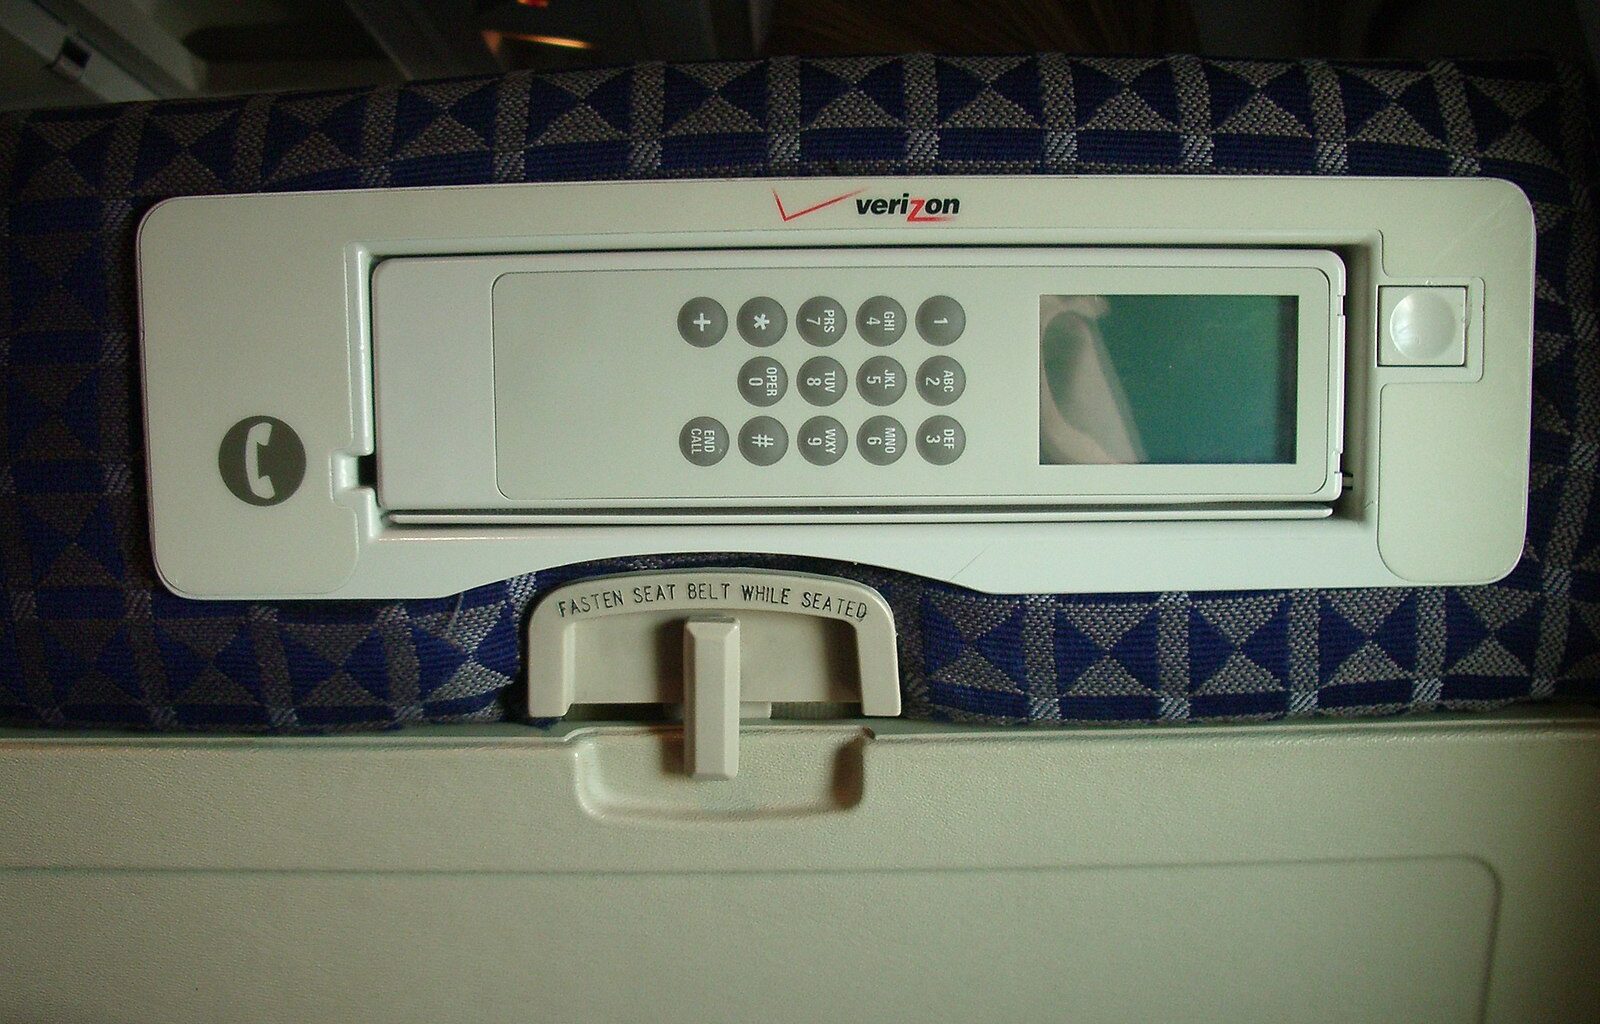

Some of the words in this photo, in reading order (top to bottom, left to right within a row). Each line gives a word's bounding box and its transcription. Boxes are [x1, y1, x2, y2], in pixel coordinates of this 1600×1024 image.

[856, 193, 960, 222] verizon
[806, 317, 821, 325] 7
[824, 309, 835, 333] PRS
[867, 316, 880, 326] 4
[884, 311, 894, 331] GHI
[749, 377, 763, 386] 0
[766, 367, 777, 396] OPER
[807, 377, 821, 386] 8
[825, 370, 835, 393] TUV
[866, 376, 881, 385] 5
[885, 369, 895, 389] JKL
[926, 378, 940, 386] 2
[943, 370, 954, 392] ABC
[691, 428, 702, 454] CALL
[704, 430, 715, 453] END
[808, 437, 822, 446] 9
[825, 428, 836, 454] WXY
[867, 436, 881, 445] 6
[885, 428, 895, 454] MNO
[926, 435, 940, 444] 3
[943, 429, 954, 449] DEF
[558, 591, 623, 617] FASTEN
[633, 584, 676, 602] SEAT
[688, 583, 730, 600] BELT
[742, 585, 791, 604] WHILE
[802, 593, 867, 619] SEATED
